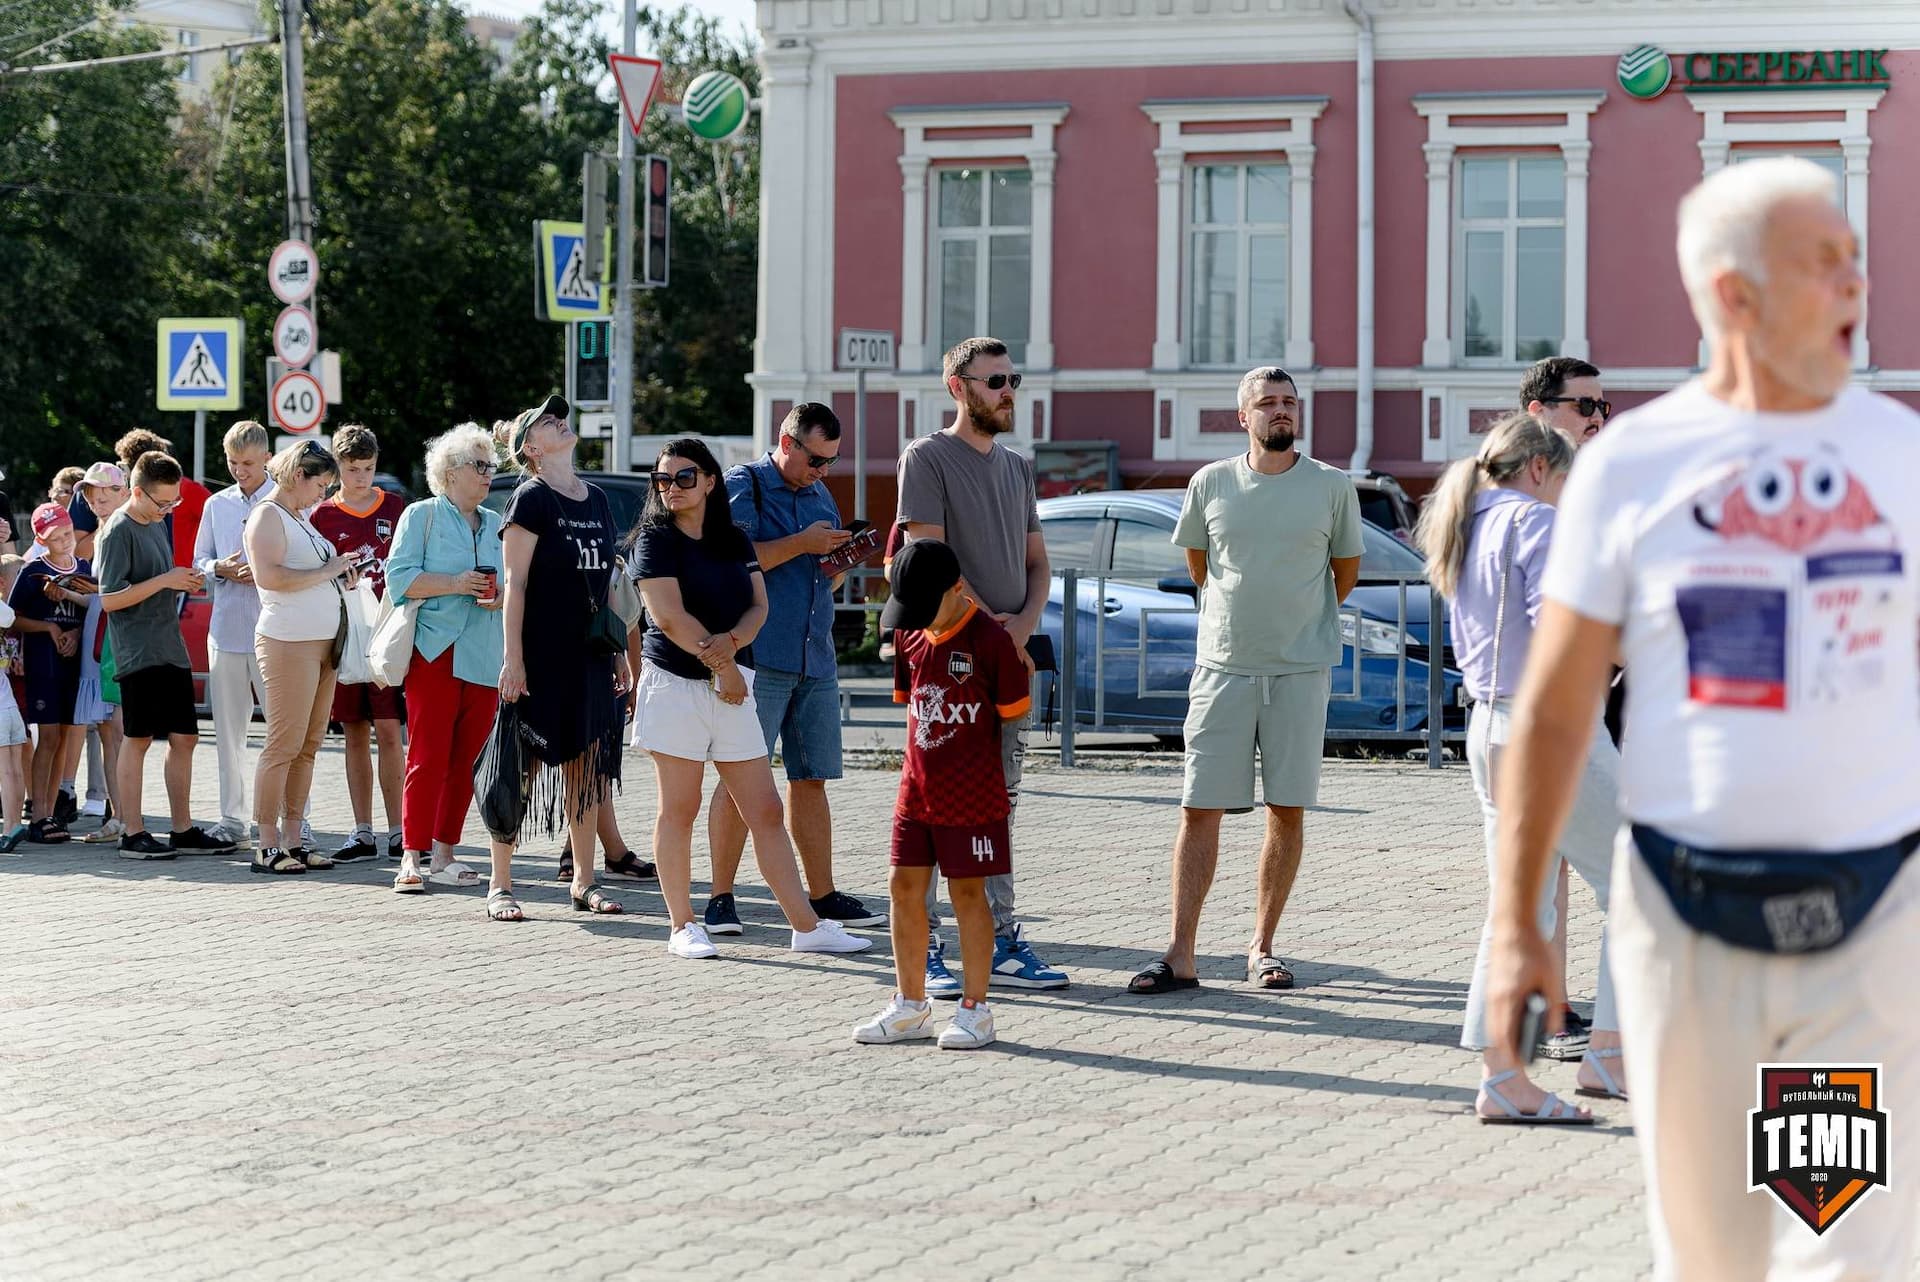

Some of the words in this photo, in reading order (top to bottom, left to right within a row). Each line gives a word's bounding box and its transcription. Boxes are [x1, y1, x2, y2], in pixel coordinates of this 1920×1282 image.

[1684, 49, 1889, 82] СБЕРБАНК
[848, 337, 889, 362] СТОП
[283, 391, 313, 413] 40
[951, 661, 971, 673] ТЕМП
[972, 835, 994, 862] 44
